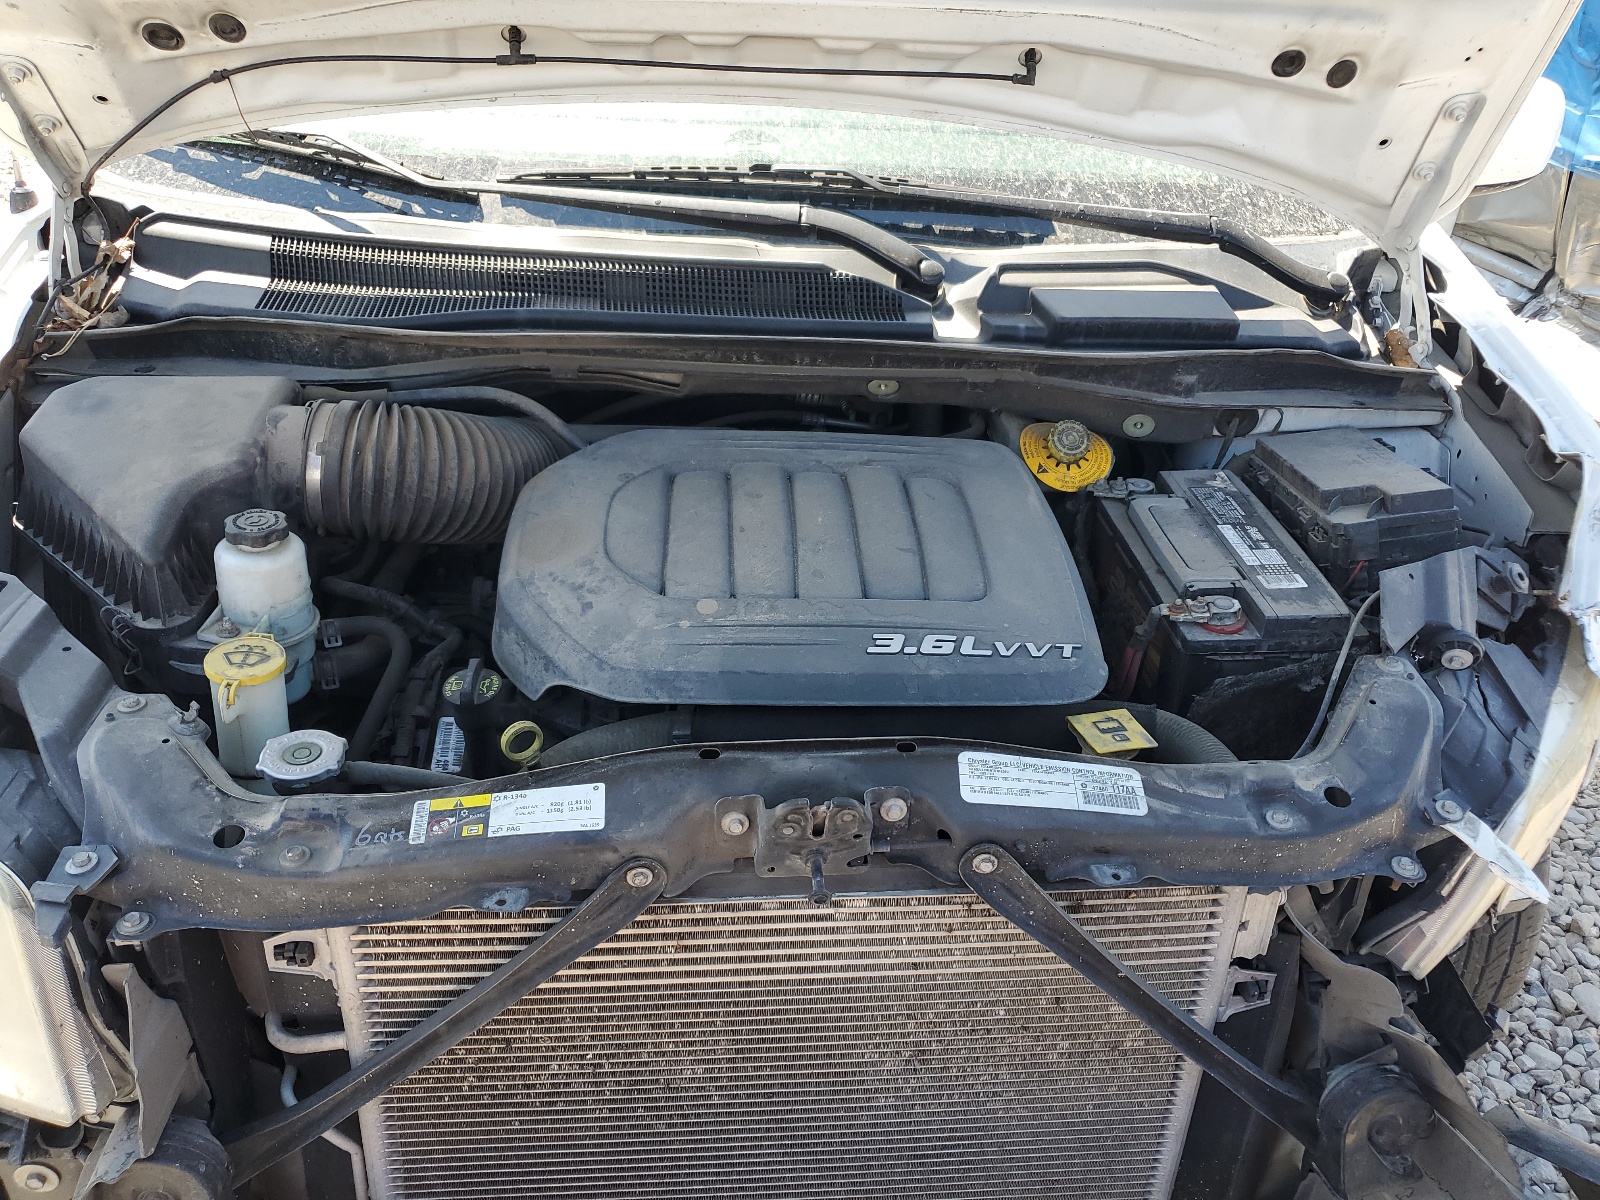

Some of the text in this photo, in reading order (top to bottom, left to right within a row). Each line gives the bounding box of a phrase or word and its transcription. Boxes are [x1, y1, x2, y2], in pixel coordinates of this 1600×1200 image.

[992, 759, 1009, 767] Group
[1045, 764, 1071, 773] EMISSION
[1071, 767, 1095, 776] CONTROL
[1097, 770, 1134, 780] INFORMATION
[355, 821, 372, 846] 6
